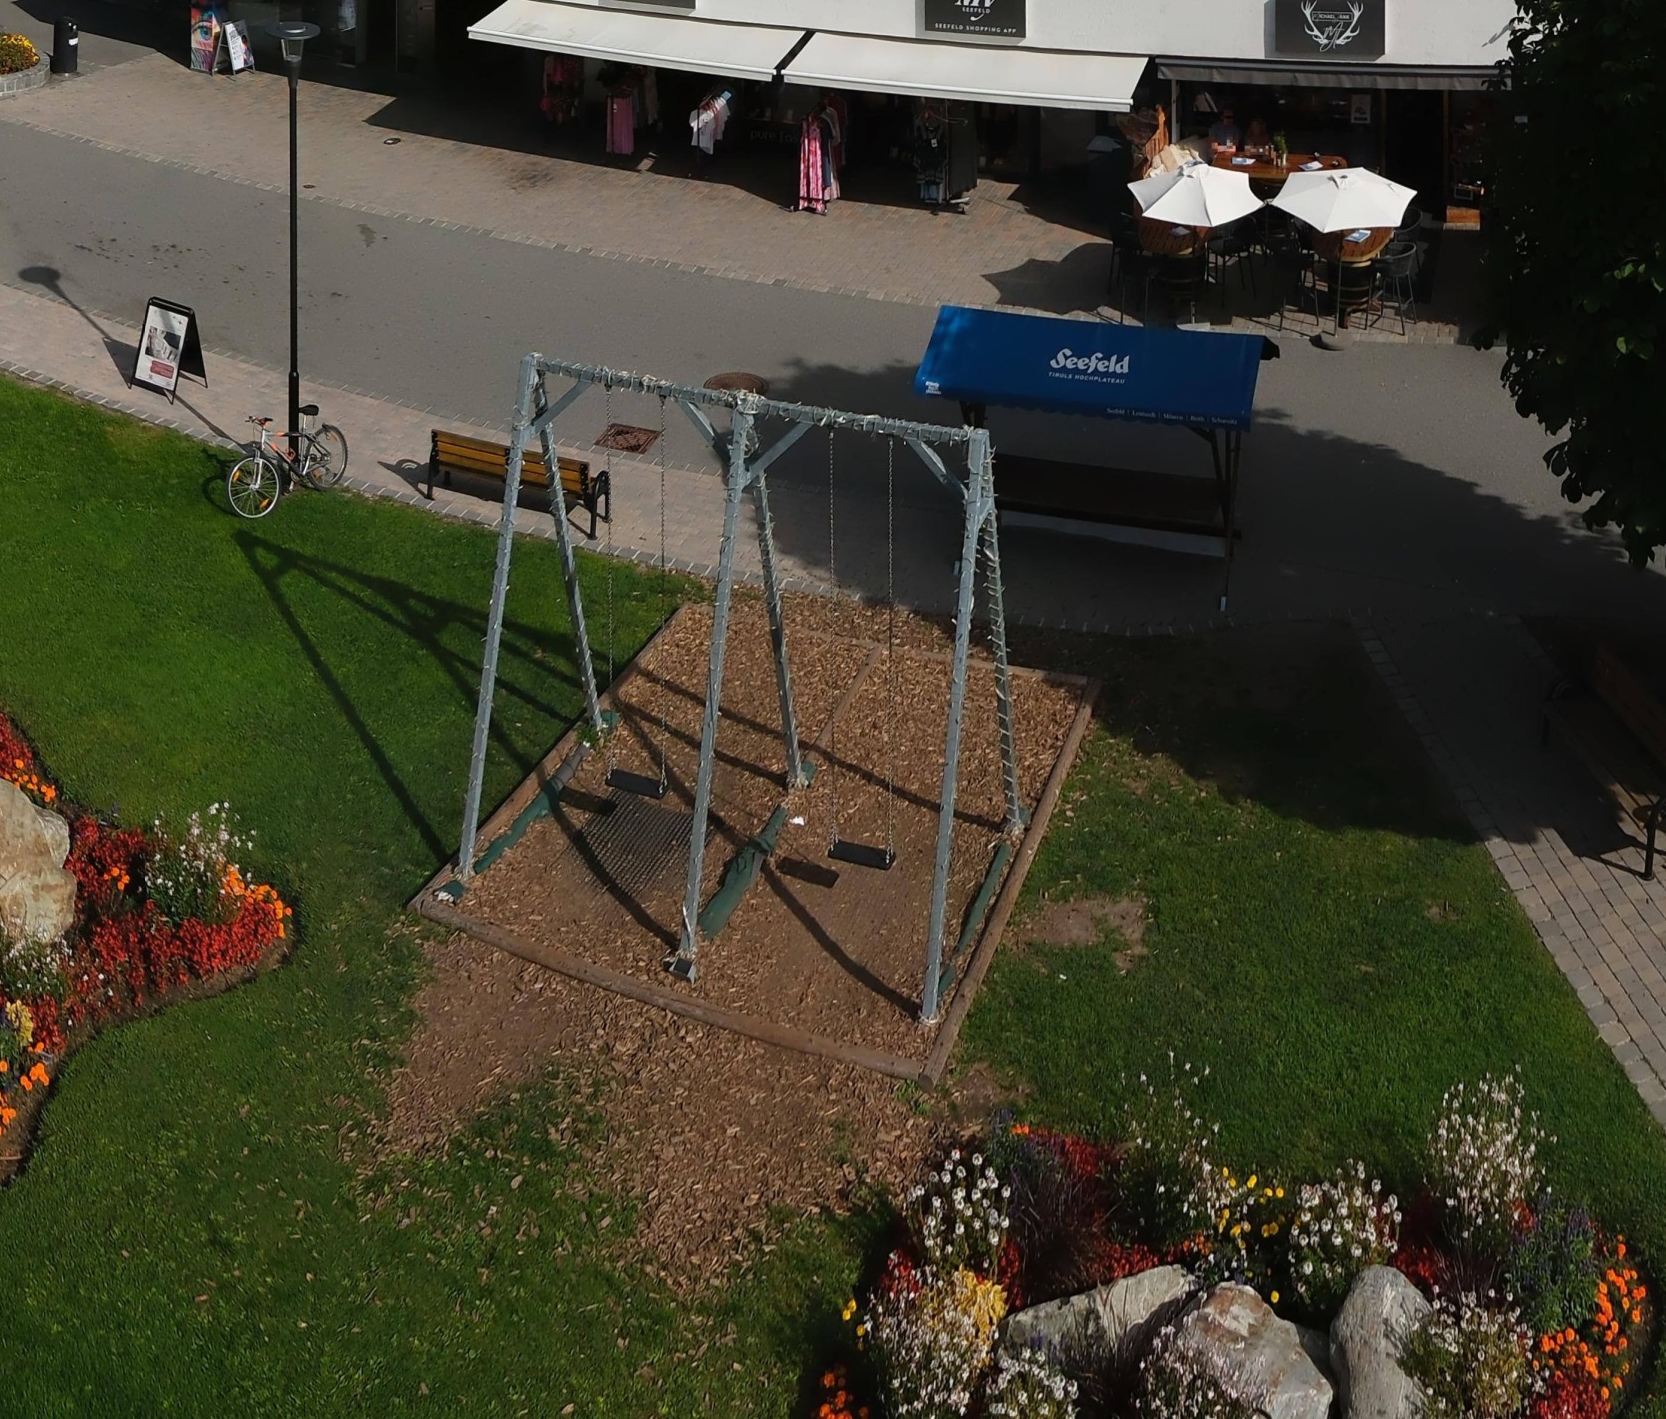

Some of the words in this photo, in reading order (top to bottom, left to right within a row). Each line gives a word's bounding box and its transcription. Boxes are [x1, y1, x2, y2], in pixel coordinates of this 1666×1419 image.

[966, 25, 996, 33] SHOPPING
[1050, 349, 1130, 375] Seefeld
[1048, 372, 1073, 380] TIROLS
[1074, 375, 1125, 385] HOCHPLATEAU
